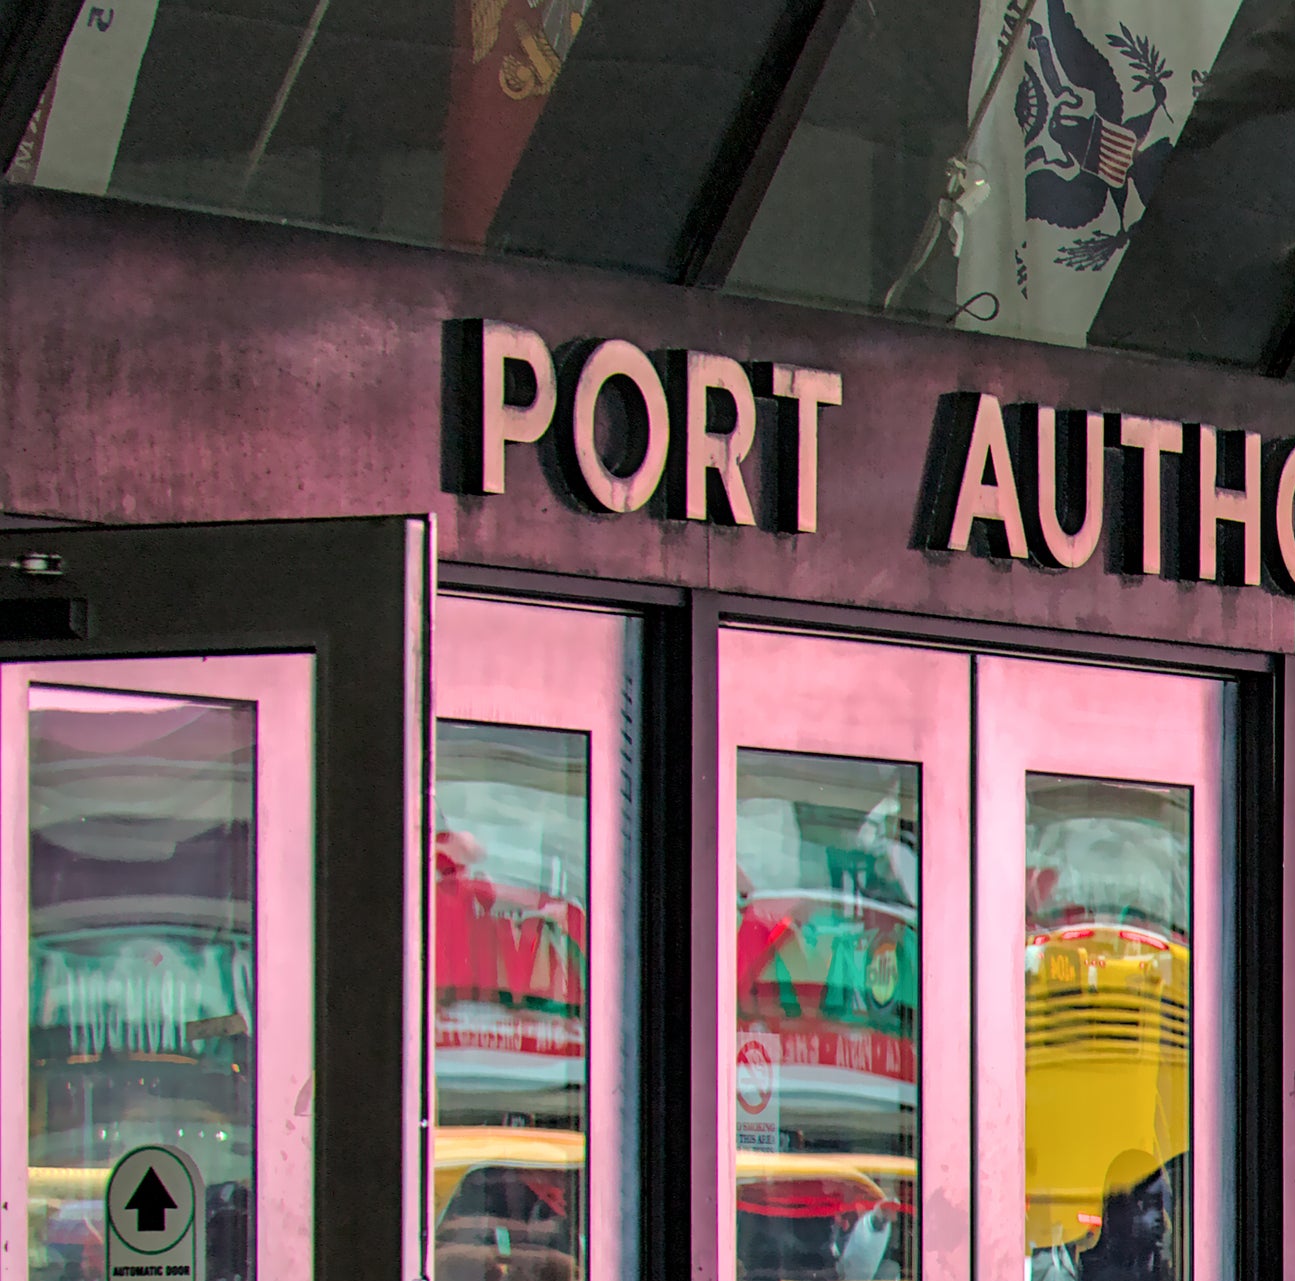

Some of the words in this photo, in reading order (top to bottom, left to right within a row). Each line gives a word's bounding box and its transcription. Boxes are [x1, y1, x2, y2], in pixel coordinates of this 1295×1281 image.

[482, 320, 843, 534] PORT
[743, 1121, 777, 1132] SMOKING
[739, 1134, 756, 1144] THIS
[113, 1265, 163, 1277] AUTOMATIC
[165, 1265, 190, 1276] DOOR
